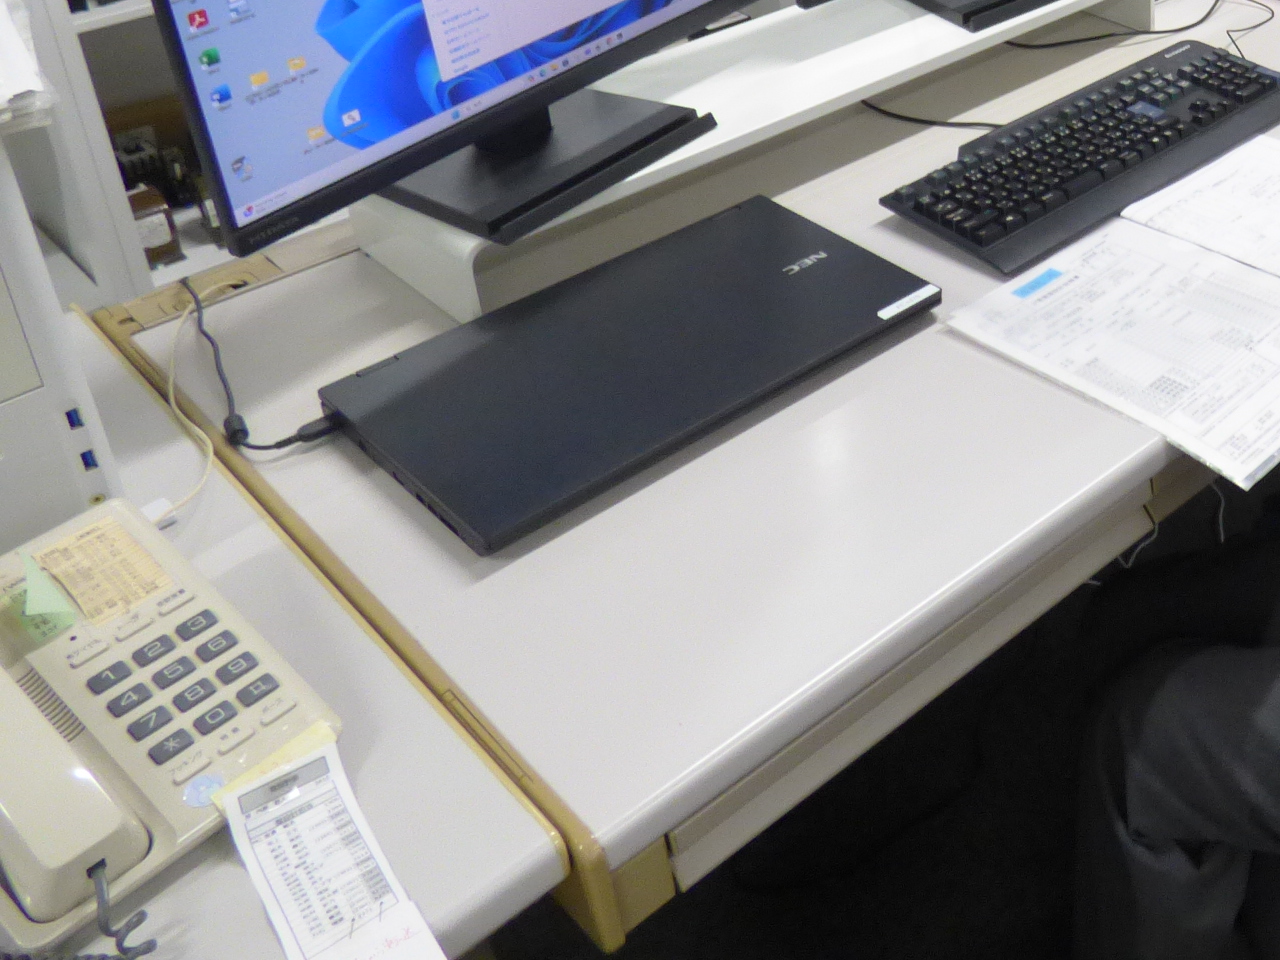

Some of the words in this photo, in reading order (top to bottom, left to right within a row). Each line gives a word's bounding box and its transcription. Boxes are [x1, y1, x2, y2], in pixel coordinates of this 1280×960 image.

[782, 250, 828, 276] NEC
[101, 669, 117, 681] 1
[143, 641, 165, 658] 2
[186, 615, 207, 631] 3
[120, 691, 139, 707] 4
[163, 663, 185, 679] 5
[207, 636, 227, 652] 6
[139, 711, 158, 727] 7
[184, 685, 205, 701] 8
[227, 658, 248, 673] 9
[204, 708, 225, 725] 0
